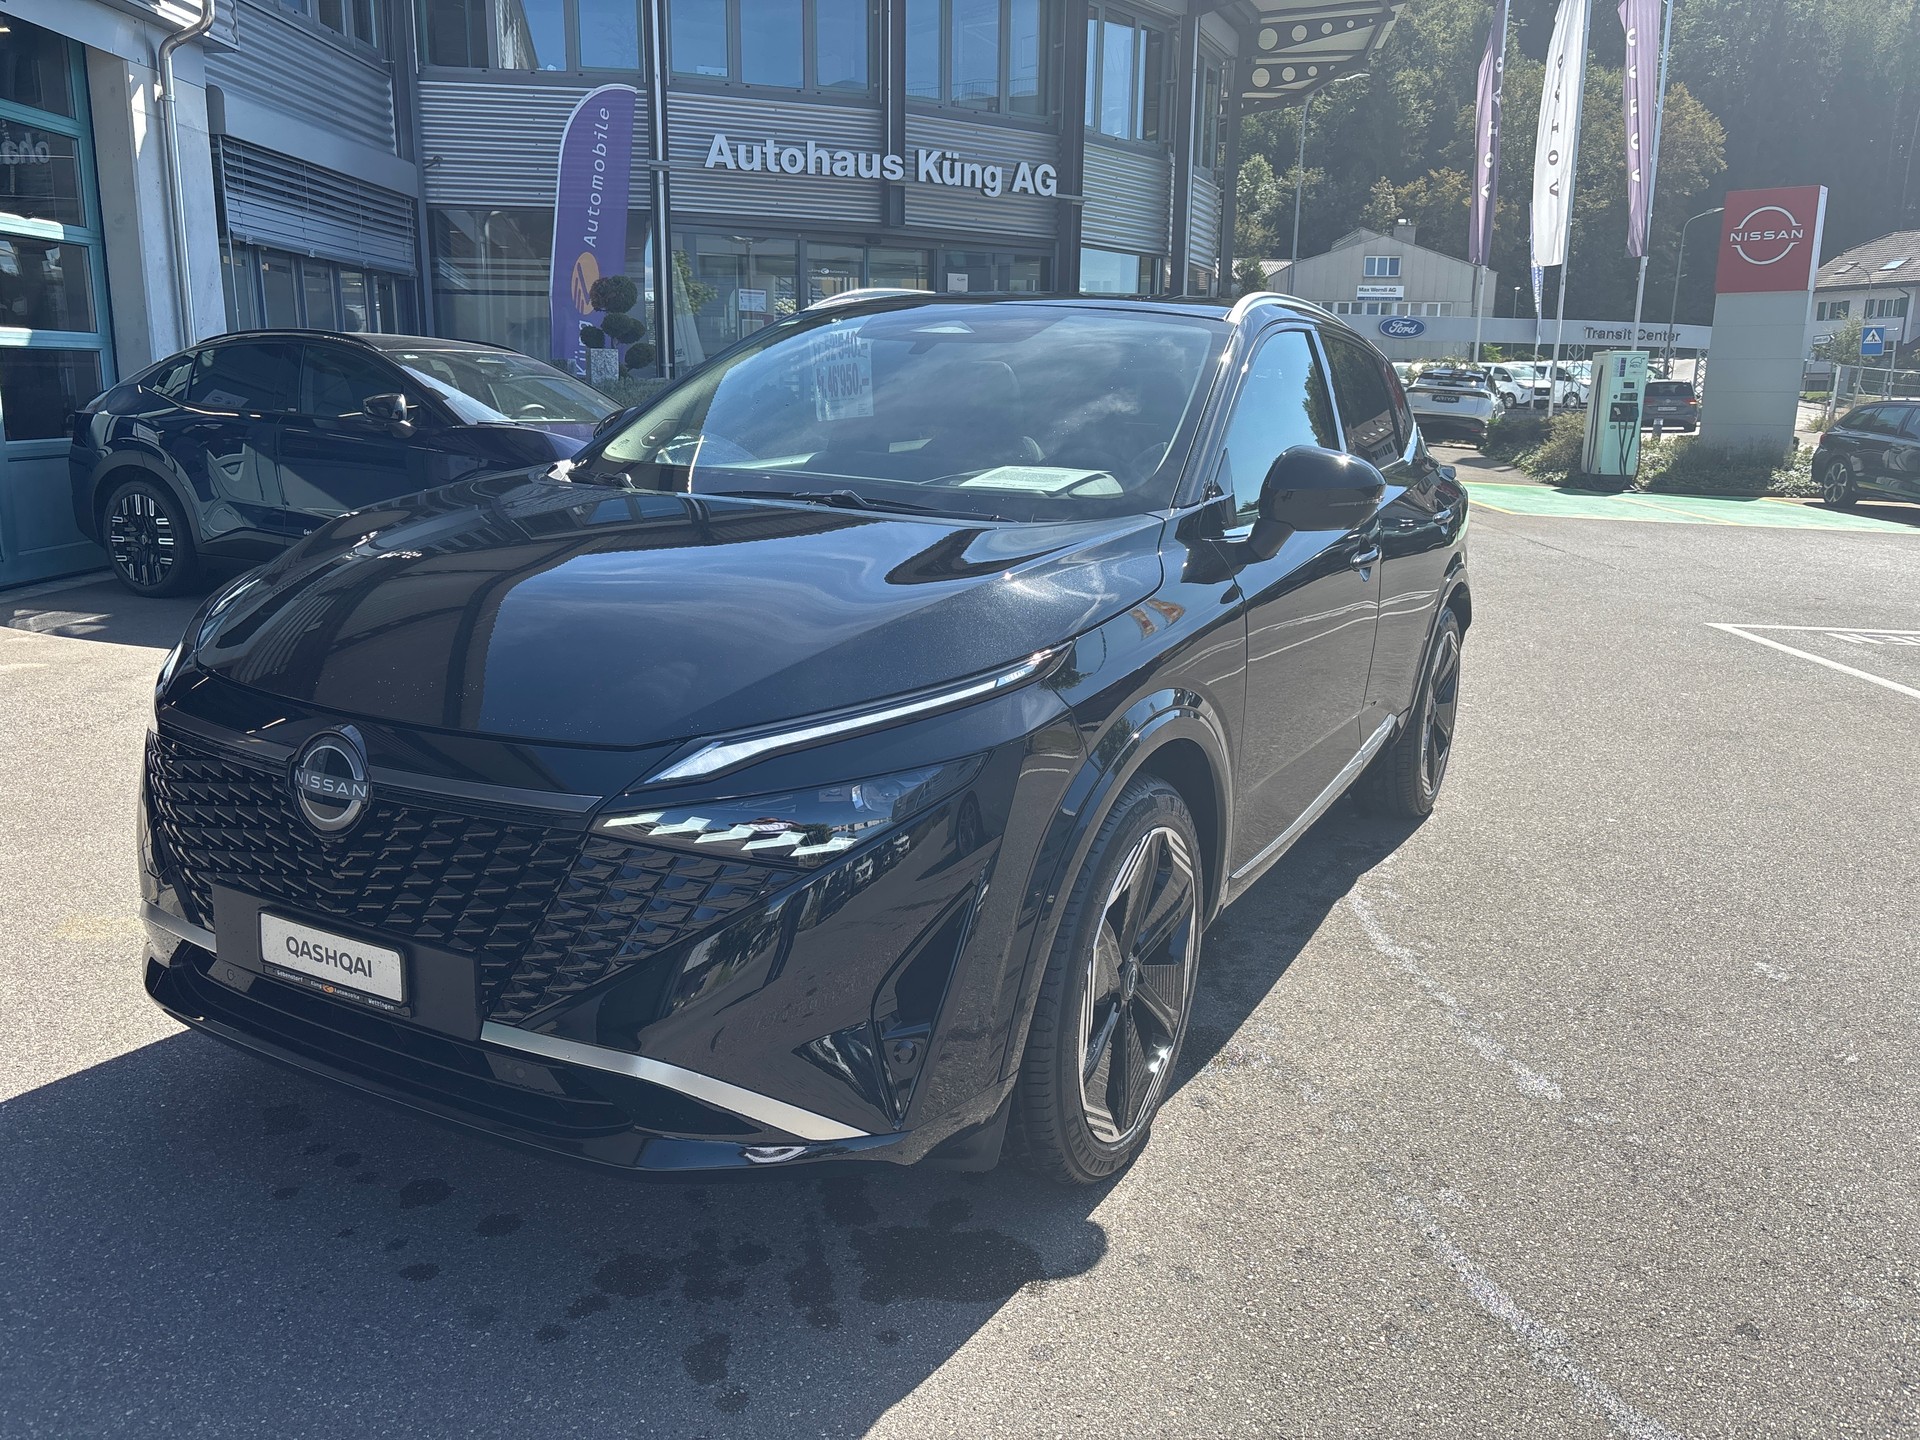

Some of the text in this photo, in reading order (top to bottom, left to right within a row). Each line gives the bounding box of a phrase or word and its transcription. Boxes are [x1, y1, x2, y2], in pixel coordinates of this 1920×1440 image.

[583, 107, 610, 249] Automobile
[704, 133, 1058, 199] Autohaus Küng AG
[1729, 229, 1804, 242] NISSAN
[1388, 320, 1418, 334] Ford
[1585, 326, 1681, 342] Transit Center
[294, 769, 367, 798] NISSAN
[285, 936, 373, 979] QASHQAI
